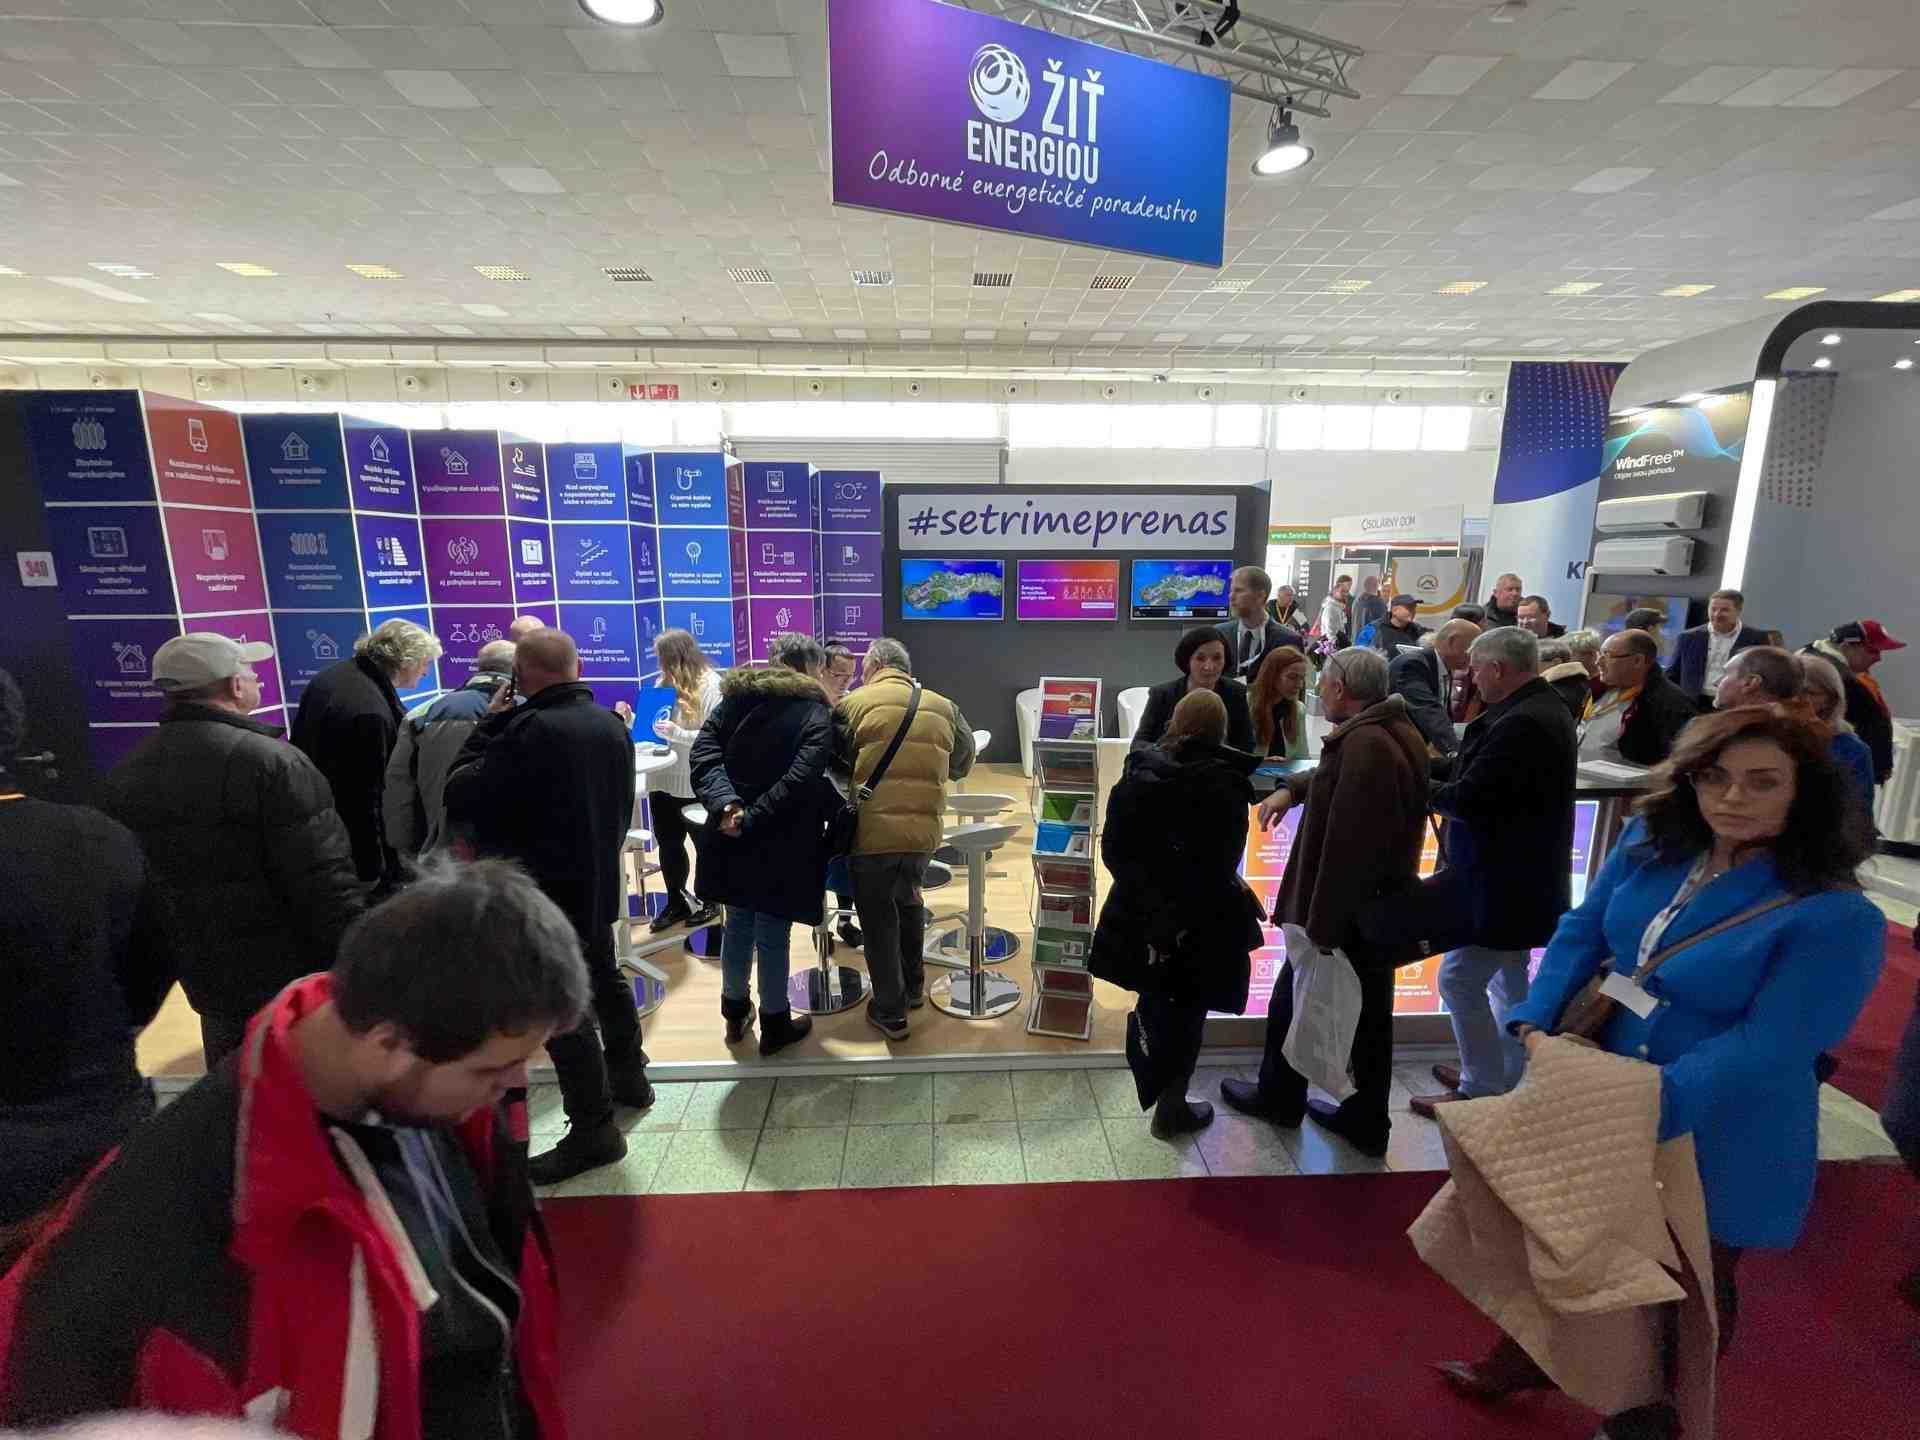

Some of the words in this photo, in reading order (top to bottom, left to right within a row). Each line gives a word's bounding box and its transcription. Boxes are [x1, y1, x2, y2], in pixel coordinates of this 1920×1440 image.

[1041, 58, 1105, 143] ŽIŤ
[868, 149, 965, 193] Odborné
[972, 180, 1086, 214] energetické
[1091, 194, 1198, 224] poradenstvo
[966, 119, 1100, 185] ENERGIOU
[908, 500, 1228, 548] #setrimeprenas
